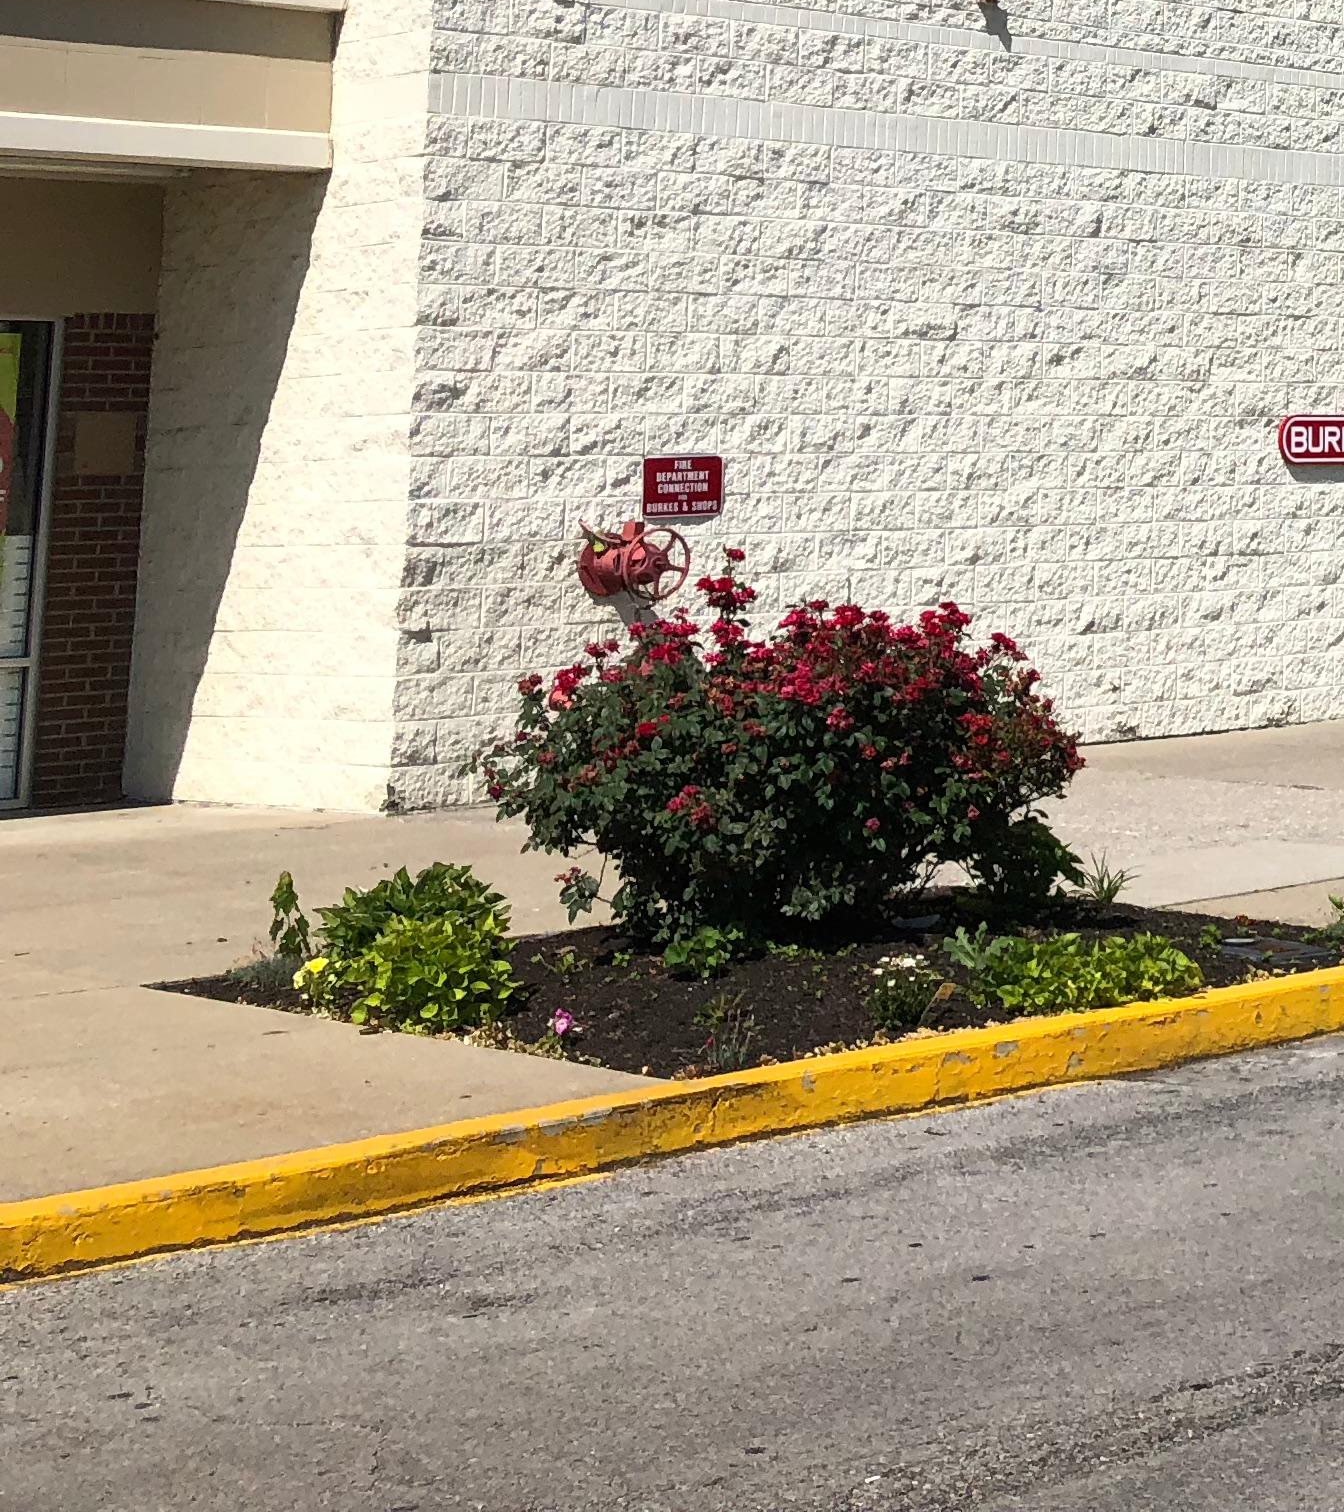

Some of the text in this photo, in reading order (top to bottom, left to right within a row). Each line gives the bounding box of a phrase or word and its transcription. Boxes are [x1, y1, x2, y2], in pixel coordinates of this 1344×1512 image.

[674, 460, 692, 470] FIRE
[656, 471, 709, 482] DEPARTMENT
[658, 482, 708, 494] CONNECTION
[646, 500, 717, 513] BURKES & SHOPS
